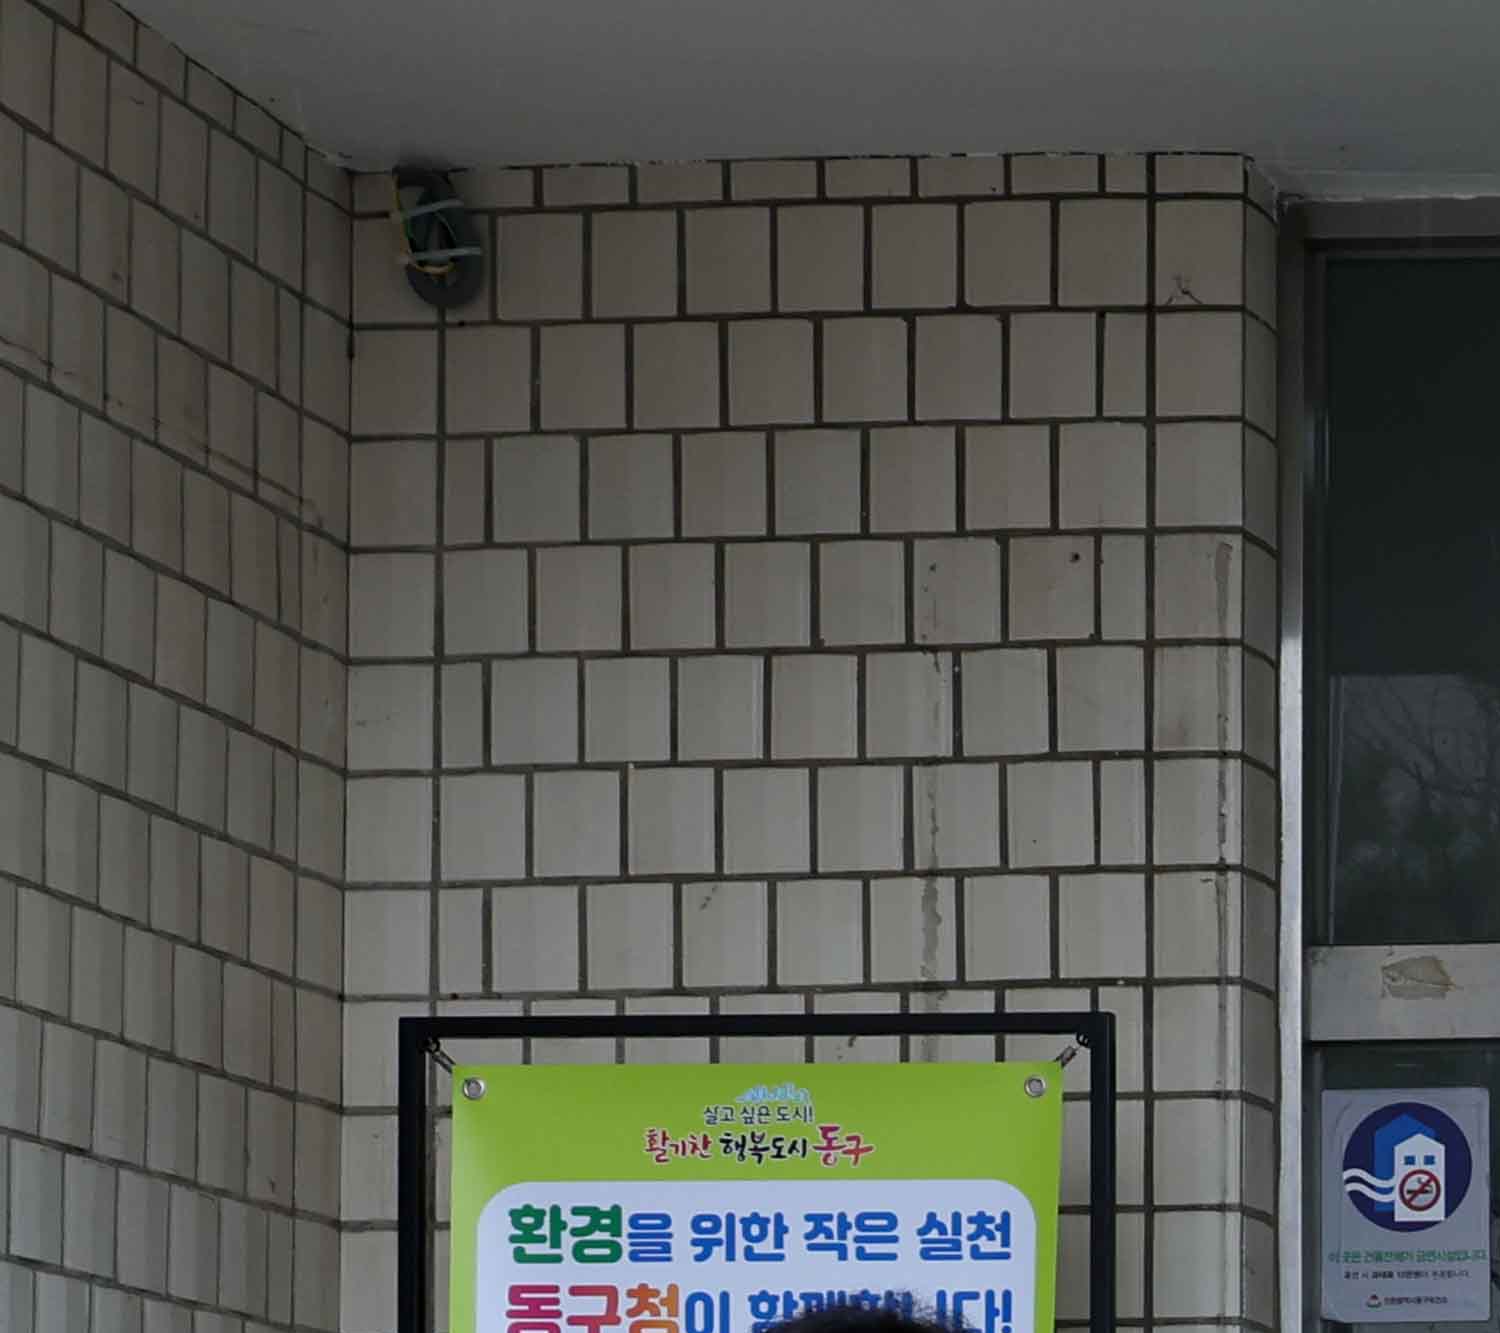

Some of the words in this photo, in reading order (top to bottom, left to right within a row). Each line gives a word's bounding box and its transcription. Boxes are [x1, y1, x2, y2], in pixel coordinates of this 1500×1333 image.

[703, 1105, 736, 1125] 살고
[739, 1106, 772, 1125] 싶은
[776, 1105, 814, 1124] 도시!
[644, 1127, 713, 1164] 활기찬
[718, 1131, 808, 1165] 행복도시
[811, 1124, 875, 1167] 동구
[507, 1203, 674, 1264] 환경을
[689, 1210, 790, 1264] 위한
[802, 1209, 900, 1262] 작은
[915, 1209, 1013, 1262] 실천
